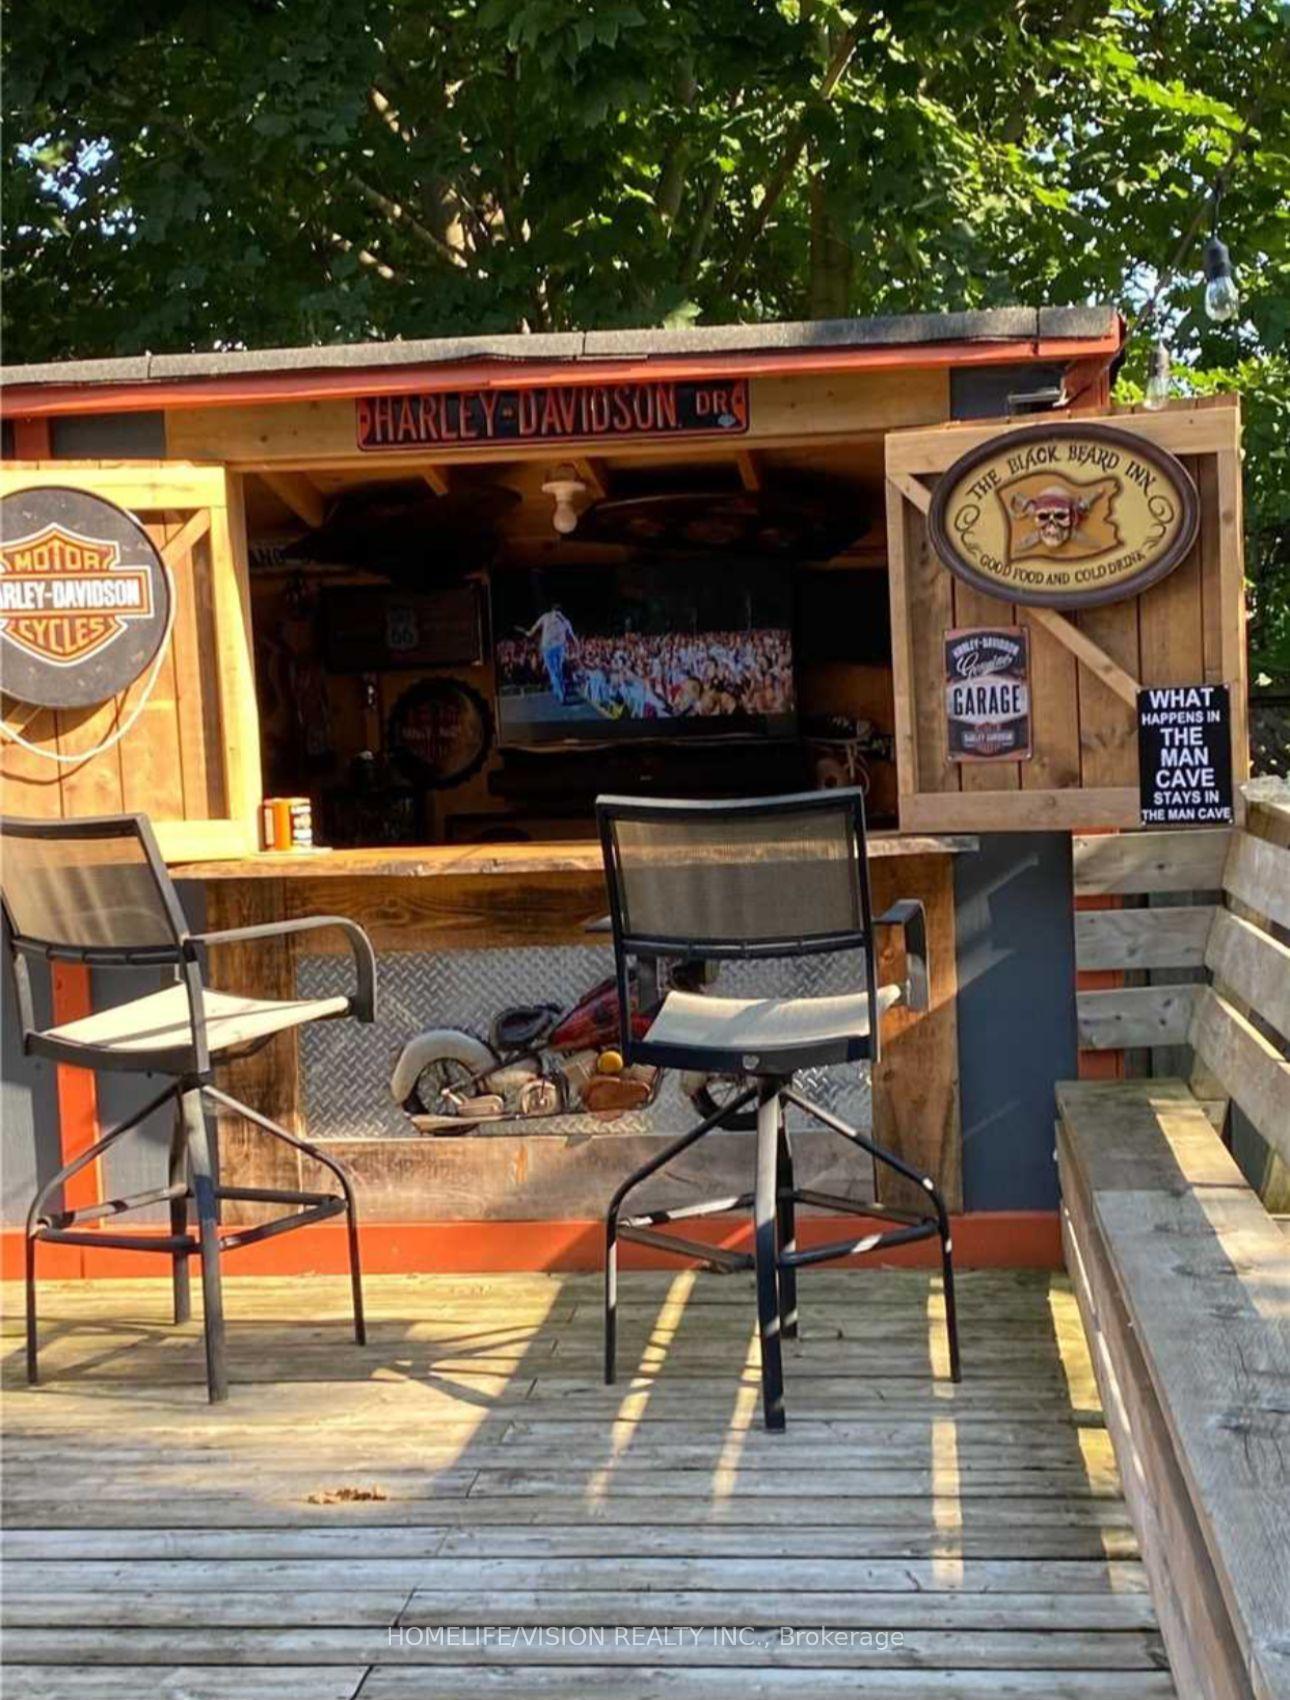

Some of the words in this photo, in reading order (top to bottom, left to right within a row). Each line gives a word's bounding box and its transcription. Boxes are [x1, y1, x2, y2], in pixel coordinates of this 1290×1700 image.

[695, 389, 728, 416] DR
[965, 468, 1002, 500] THE
[1007, 445, 1062, 476] BLACK
[1067, 444, 1121, 473] BEARD
[1125, 460, 1157, 497] INN
[14, 538, 101, 572] MOTOR
[979, 554, 1012, 577] GOOD
[1013, 567, 1045, 585] FOOD
[1046, 572, 1070, 585] AND
[1074, 565, 1107, 583] COLD
[19, 617, 105, 655] CYCLES
[953, 684, 1021, 716] GARAGE
[1149, 687, 1214, 709] WHAT
[1141, 711, 1204, 726] HAPPENS
[1206, 709, 1220, 723] IN
[1160, 726, 1203, 747] THE
[1160, 746, 1209, 767] MAN
[1155, 767, 1215, 788] CAVE
[1153, 790, 1201, 805] STAYS
[1204, 789, 1219, 804] IN
[1142, 809, 1165, 821] THE
[1167, 808, 1195, 820] MAN
[1198, 806, 1231, 819] CAVE
